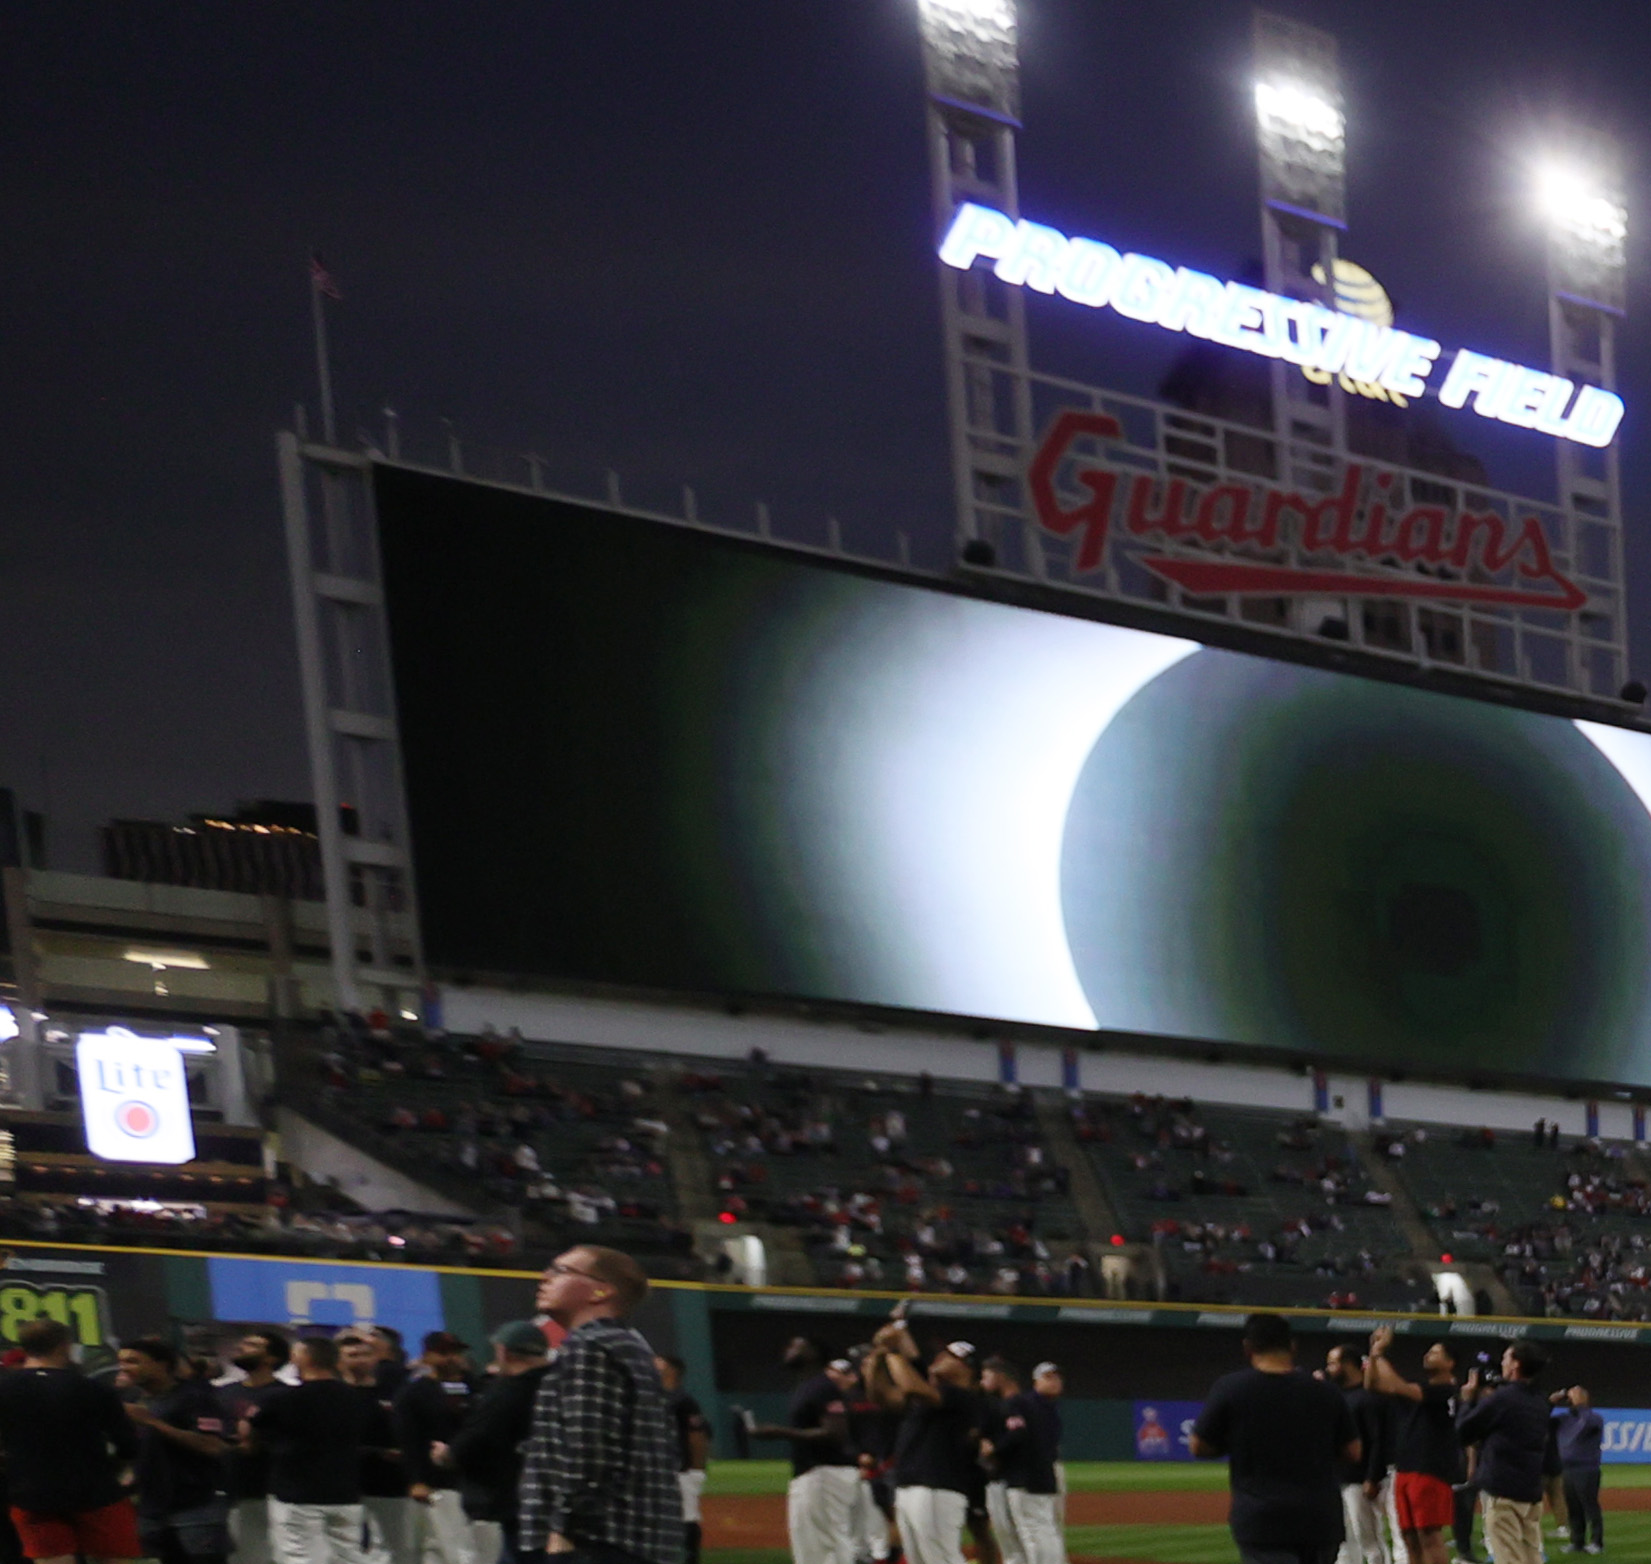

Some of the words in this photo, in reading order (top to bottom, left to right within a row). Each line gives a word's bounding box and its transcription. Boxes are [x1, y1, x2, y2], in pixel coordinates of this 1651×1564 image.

[938, 202, 1442, 398] PROGRESSIVE
[1438, 348, 1626, 449] FIELD
[1027, 408, 1560, 577] Guardians
[0, 1286, 102, 1347] 811
